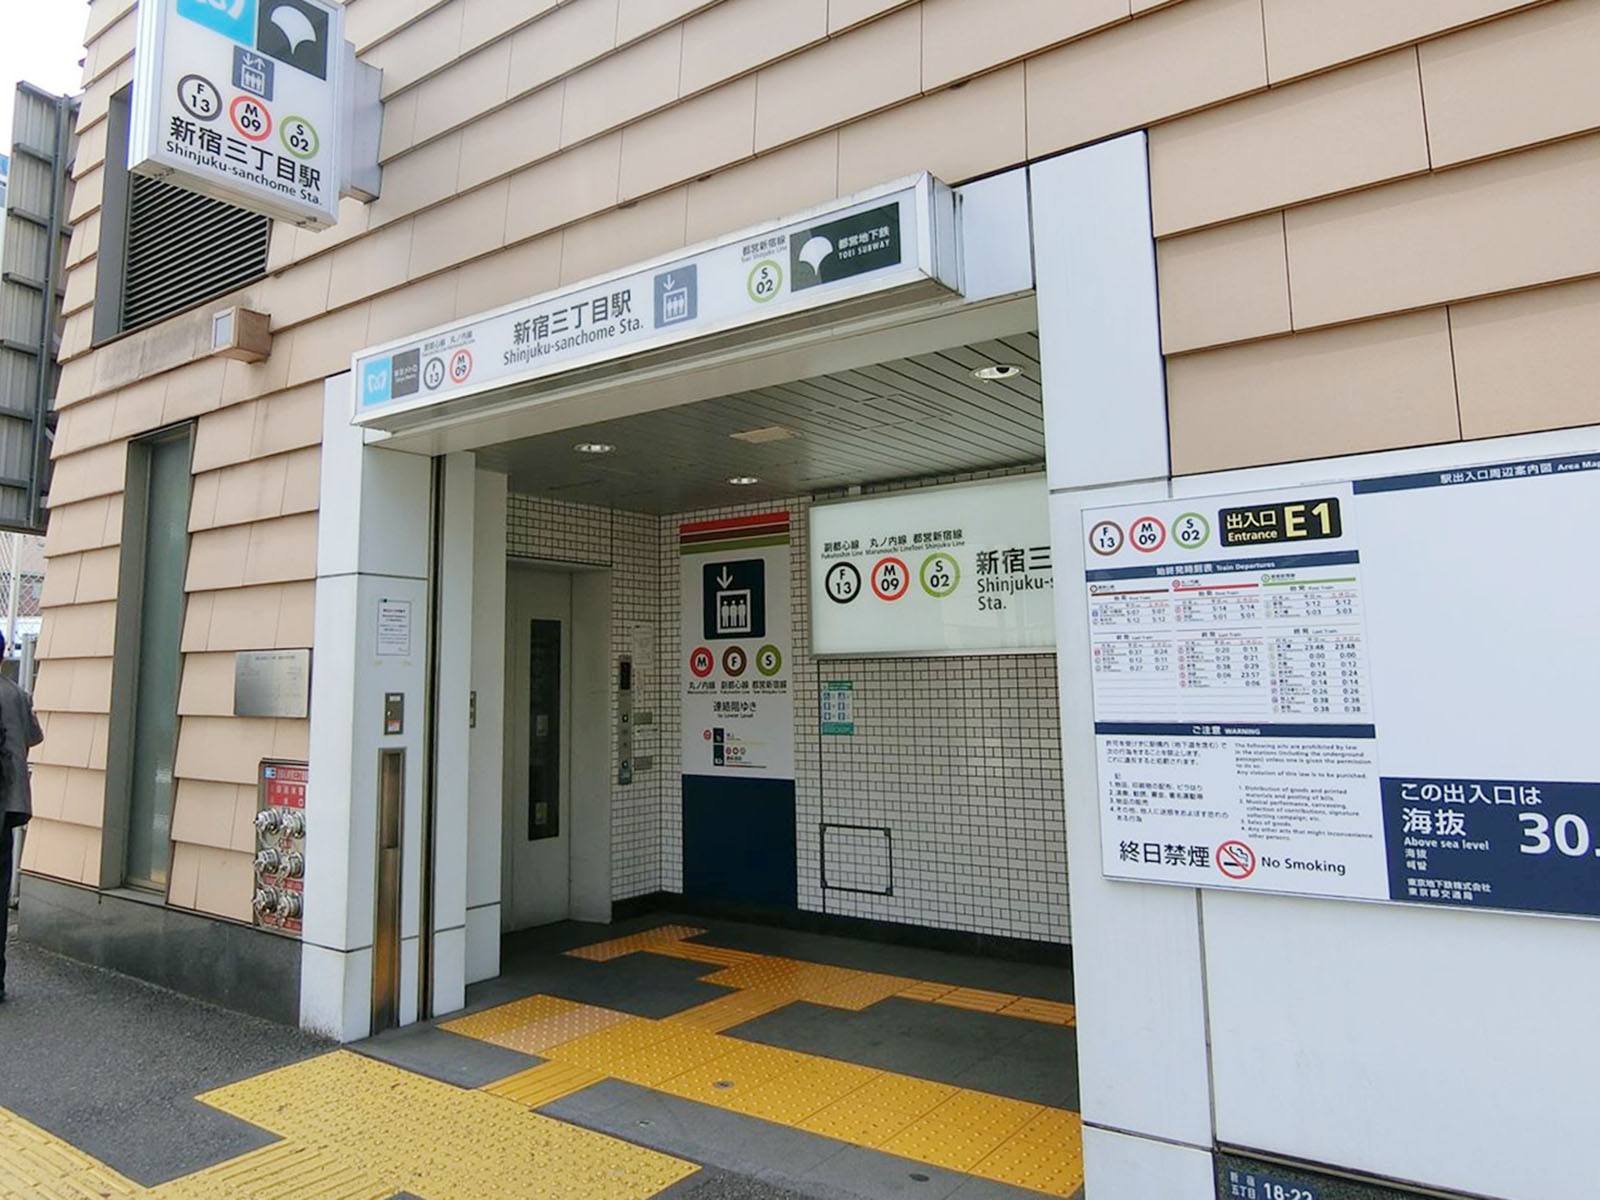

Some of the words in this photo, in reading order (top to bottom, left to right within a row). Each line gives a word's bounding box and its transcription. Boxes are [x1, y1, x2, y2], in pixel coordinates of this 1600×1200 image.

[196, 83, 205, 95] F
[190, 94, 211, 113] 13
[244, 102, 259, 119] M
[240, 115, 261, 133] 09
[296, 123, 304, 136] S
[289, 135, 309, 153] 02
[170, 116, 321, 192] 新宿三丁目駅
[166, 140, 297, 197] Shinjuku-sanchome
[300, 189, 323, 207] Sta.
[838, 226, 890, 250] 都営地下鉄
[838, 248, 856, 260] TOEI
[857, 239, 891, 255] SUBWAY
[761, 267, 769, 280] S
[756, 279, 774, 295] 02
[513, 289, 632, 345] 新宿三丁目駅
[503, 326, 616, 366] Shinjuku-sanchome
[619, 317, 644, 334] Sta.
[457, 354, 465, 365] M
[432, 362, 437, 372] F
[455, 364, 467, 377] 09
[429, 372, 440, 384] 13
[1440, 463, 1553, 485] 駅出入口周辺案内図
[1557, 462, 1580, 472] Area
[1186, 518, 1194, 529] S
[1226, 510, 1277, 531] 出入口
[1284, 501, 1332, 538] E1
[1103, 526, 1109, 537] F
[1141, 522, 1153, 533] M
[869, 534, 907, 549] 丸ノ内線
[913, 529, 963, 545] 都営新宿線
[1139, 533, 1157, 546] 09
[1181, 529, 1201, 542] 02
[1227, 528, 1278, 543] Entrance
[1099, 537, 1115, 549] 13
[935, 560, 944, 573] S
[976, 546, 1053, 576] 新宿三
[1216, 562, 1234, 572] Train
[1234, 560, 1276, 572] Departures
[839, 569, 846, 580] F
[884, 564, 896, 577] M
[835, 582, 852, 595] 13
[881, 579, 900, 592] 09
[930, 574, 950, 589] 02
[978, 597, 1007, 612] Sta.
[696, 655, 707, 667] M
[731, 656, 738, 667] F
[765, 654, 773, 667] S
[1192, 726, 1222, 735] ご注意
[1225, 728, 1261, 736] WARNING
[1401, 783, 1542, 805] この出入口は
[1402, 807, 1467, 837] 海抜
[1404, 836, 1438, 849] Above
[1440, 840, 1460, 849] sea
[1462, 839, 1490, 851] level
[1119, 840, 1211, 868] 終日禁煙
[1261, 856, 1281, 869] No
[1284, 857, 1346, 877] Smoking
